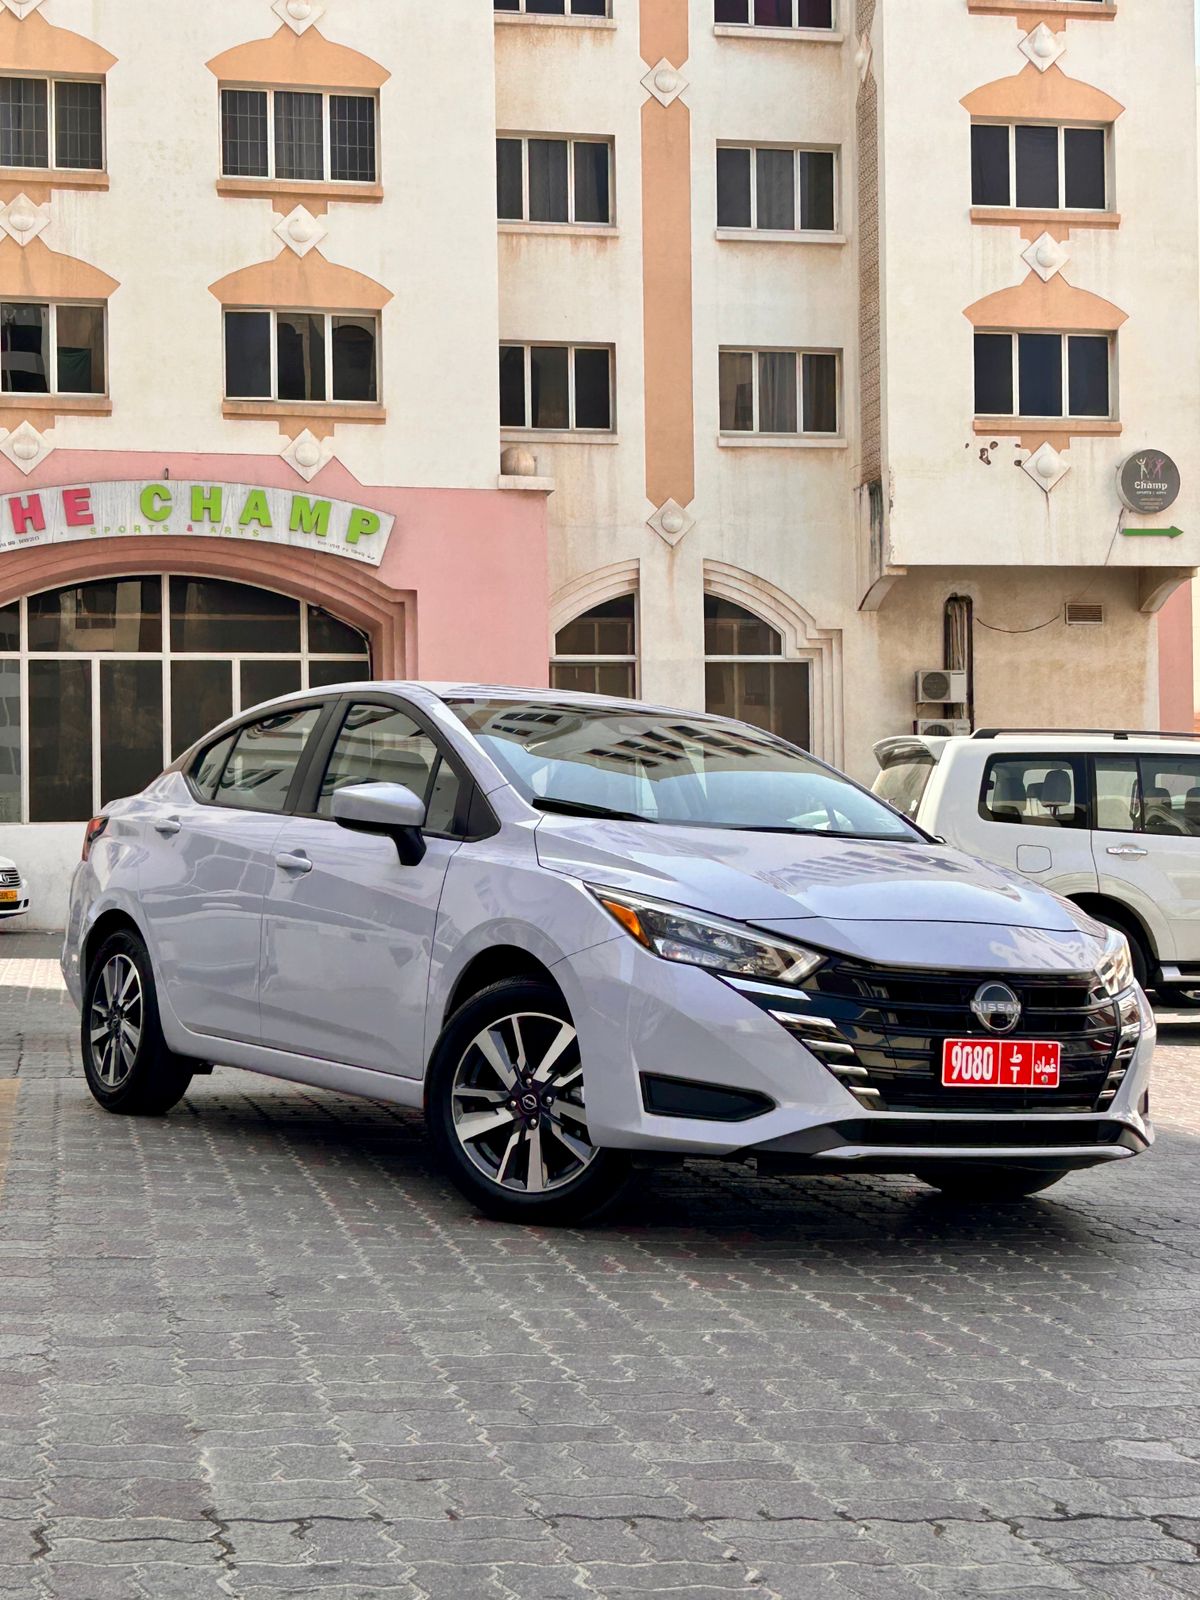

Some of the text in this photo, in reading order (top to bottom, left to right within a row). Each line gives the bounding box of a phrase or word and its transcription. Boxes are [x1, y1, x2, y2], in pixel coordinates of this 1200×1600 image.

[1134, 481, 1168, 490] Champ
[139, 483, 381, 544] CHAMP
[89, 524, 260, 538] SPORTS & ARTS
[971, 1002, 1021, 1013] NISSAN
[951, 1045, 993, 1081] 9080
[1010, 1066, 1020, 1083] T
